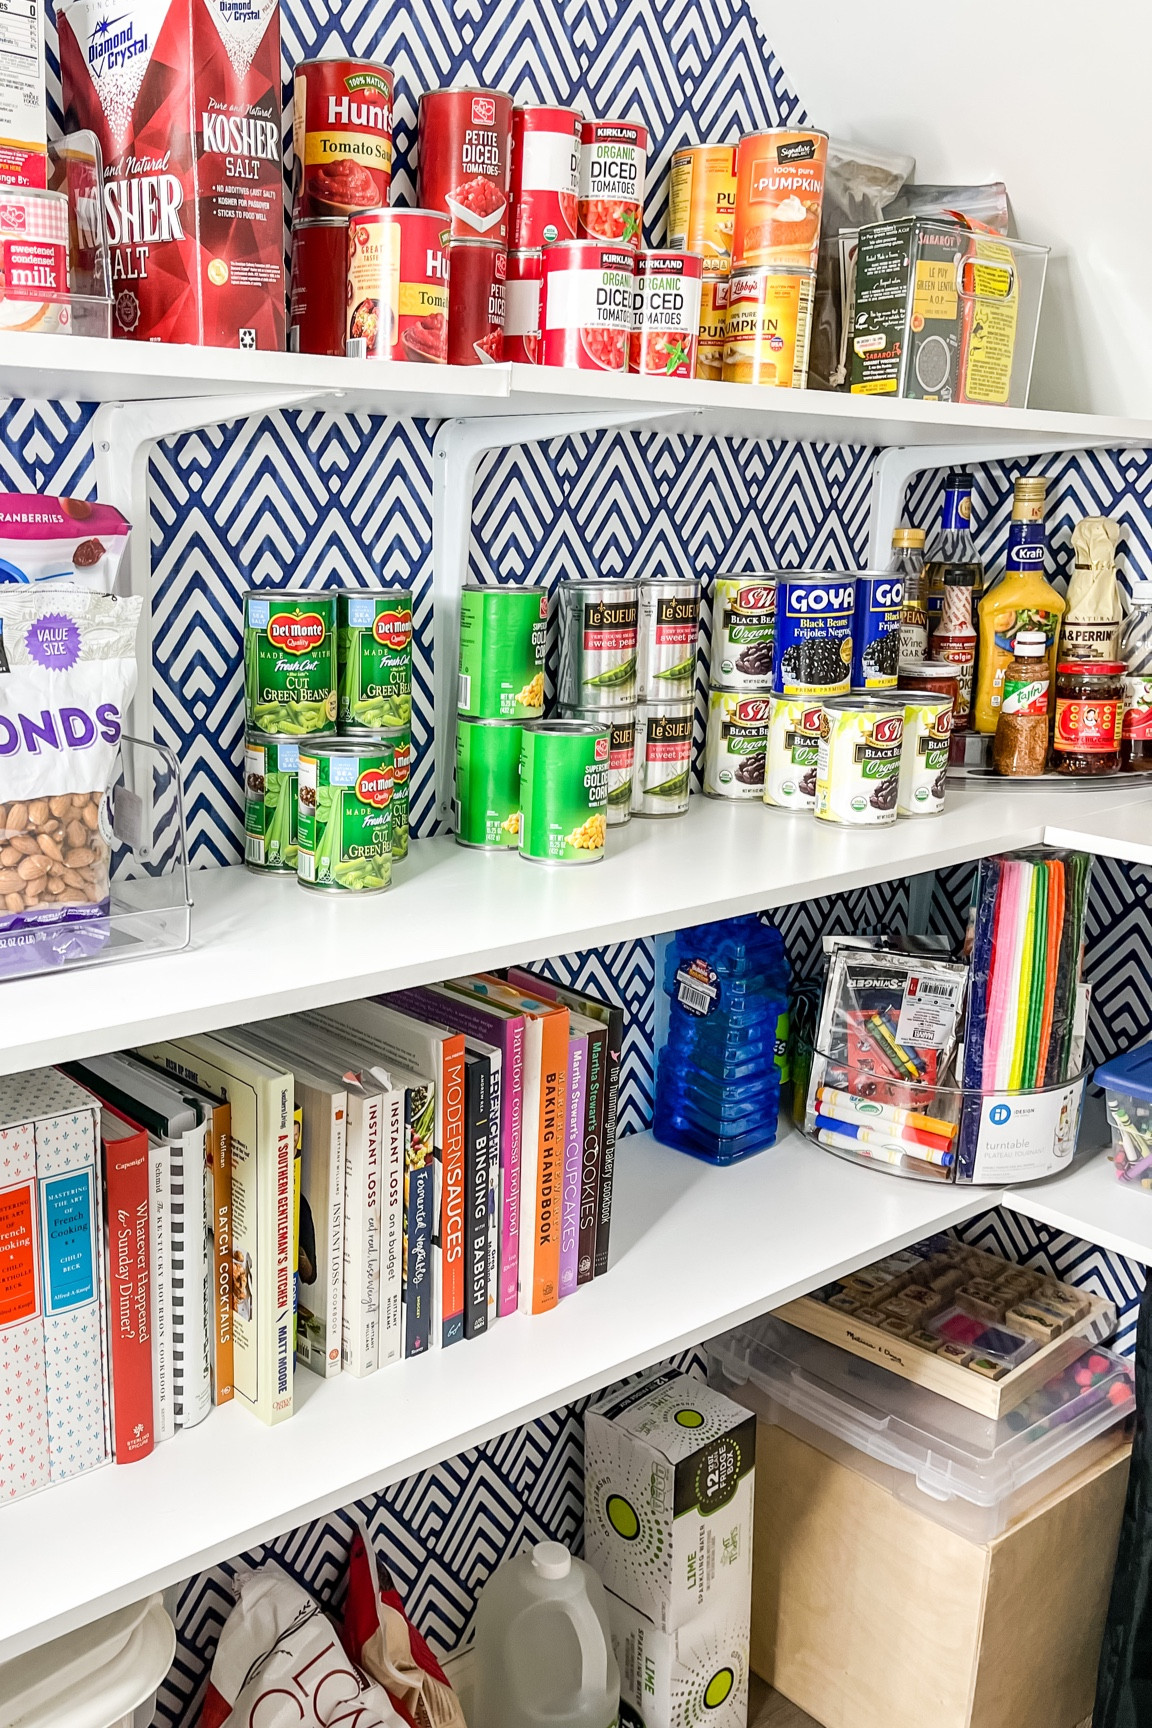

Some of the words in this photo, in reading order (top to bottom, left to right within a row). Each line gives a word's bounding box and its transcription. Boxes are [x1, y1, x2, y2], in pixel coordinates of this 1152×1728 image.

[220, 0, 252, 11] Diamond
[234, 10, 260, 23] Crystal
[88, 22, 133, 64] Diamond
[107, 34, 149, 70] Crystal
[349, 76, 366, 87] 100%
[207, 96, 228, 110] Pure
[229, 103, 243, 112] and
[245, 104, 273, 119] Natural
[202, 112, 280, 161] KOSHER
[465, 130, 498, 146] PETITE
[597, 128, 637, 139] KIRKLAND
[320, 139, 374, 156] Tomato
[462, 144, 499, 165] DICED
[596, 145, 636, 161] ORGANIC
[104, 160, 123, 178] and
[125, 151, 170, 174] Natural
[226, 157, 260, 179] SALT
[462, 163, 499, 176] TOMATOES
[590, 161, 637, 181] DICED
[773, 166, 797, 174] 100%
[798, 167, 814, 176] pure
[216, 185, 225, 193] NO
[225, 186, 250, 196] ADDITIVES
[591, 180, 636, 195] TOMATOES
[758, 177, 821, 193] PUMPKIN
[217, 197, 238, 207] KOSHER
[238, 199, 248, 208] FOR
[247, 200, 270, 210] PASSOVER
[217, 210, 235, 219] STICKS
[235, 211, 242, 219] TO
[10, 244, 55, 257] sweetened
[11, 255, 55, 266] condensed
[639, 259, 683, 269] KIRKLAND
[11, 266, 57, 288] milk
[929, 267, 937, 278] LE
[937, 267, 949, 278] PUY
[733, 280, 758, 295] Libby's
[916, 280, 937, 291] GREEN
[865, 350, 896, 361] SABAROT
[1019, 548, 1044, 559] Kraft
[790, 587, 855, 612] GOYA
[603, 608, 637, 624] SUEUR
[730, 615, 759, 624] BLACK
[800, 618, 825, 628] Black
[827, 618, 848, 627] Beans
[37, 627, 69, 642] VALUE
[272, 624, 290, 637] Del
[290, 624, 323, 637] Monte
[378, 622, 393, 634] Del
[793, 628, 827, 640] Frijoles
[286, 638, 309, 648] Quality
[588, 639, 617, 648] sweet
[660, 633, 687, 641] sweet
[45, 642, 67, 656] SIZE
[260, 651, 284, 659] MADE
[311, 650, 331, 658] WITH
[364, 648, 389, 656] MADE
[274, 659, 301, 672] Fresh
[286, 676, 310, 690] CUT
[389, 671, 407, 684] CUT
[263, 687, 298, 701] GREEN
[299, 688, 329, 701] BEANS
[367, 684, 399, 697] GREEN
[729, 727, 758, 736] BLACK
[928, 740, 948, 750] BLACK
[650, 751, 677, 760] sweet
[865, 749, 893, 758] BLACK
[361, 780, 377, 792] Del
[345, 807, 372, 816] MADE
[393, 804, 407, 816] CUT
[362, 814, 384, 828] Fresh
[372, 829, 389, 843] CUT
[348, 843, 382, 857] GREEN
[912, 1029, 935, 1041] MARVEL
[512, 1027, 525, 1096] barefoot
[571, 1049, 583, 1090] Martha
[590, 1041, 602, 1083] Martha
[609, 1066, 620, 1082] the
[544, 1072, 557, 1142] BAKING
[555, 1071, 566, 1145] MARTHA
[588, 1083, 600, 1132] Stewart's
[569, 1091, 581, 1141] Stewart's
[605, 1083, 619, 1149] hummingbird
[278, 1134, 289, 1143] A
[367, 1104, 378, 1166] INSTANT
[390, 1101, 400, 1164] INSTANT
[511, 1098, 522, 1165] contessa
[219, 1134, 227, 1169] Hoffman
[985, 1139, 1030, 1151] turntable
[115, 1156, 145, 1171] Caponigri
[277, 1143, 289, 1196] SOUTHERN
[603, 1150, 616, 1182] bakery
[155, 1162, 163, 1194] Schmid
[474, 1136, 488, 1219] BINGING
[580, 1134, 599, 1231] COOKIES
[48, 1186, 88, 1201] MASTERING
[367, 1171, 377, 1208] LOSS
[389, 1170, 399, 1207] LOSS
[540, 1147, 555, 1245] HANDBOOK
[54, 1200, 69, 1209] THE
[70, 1196, 83, 1205] ART
[414, 1171, 428, 1235] Fermented
[506, 1166, 522, 1237] foolproof
[562, 1142, 579, 1253] CUPCAKES
[600, 1181, 613, 1224] cookbook
[54, 1211, 84, 1227] French
[117, 1209, 130, 1228] to
[388, 1214, 395, 1229] on
[50, 1223, 89, 1240] Cooking
[136, 1199, 149, 1270] Whatever
[218, 1205, 229, 1257] BATCH
[277, 1196, 289, 1266] GENTLEMAN'S
[331, 1202, 342, 1253] INSTANT
[115, 1228, 134, 1282] Sunday
[156, 1216, 164, 1278] KENTUCKY
[60, 1252, 83, 1264] CHILD
[386, 1238, 398, 1281] budget
[62, 1263, 81, 1273] BECK
[331, 1253, 340, 1286] LOSS
[473, 1235, 486, 1305] BABISH
[5, 1282, 23, 1292] BECK
[277, 1266, 289, 1309] KITCHEN
[119, 1282, 136, 1340] Dinner?
[135, 1270, 150, 1344] Happened
[157, 1283, 165, 1338] BOURBON
[219, 1262, 231, 1345] COCKTAILS
[278, 1325, 288, 1355] MATT
[158, 1341, 166, 1403] COOKBOOK
[278, 1355, 288, 1395] MOORE
[126, 1432, 150, 1447] STERLING
[128, 1438, 149, 1451] EPICURE
[719, 1444, 727, 1490] FRIDGE
[706, 1469, 719, 1498] 12
[687, 1550, 697, 1591] LIME
[644, 1656, 656, 1696] LIME
